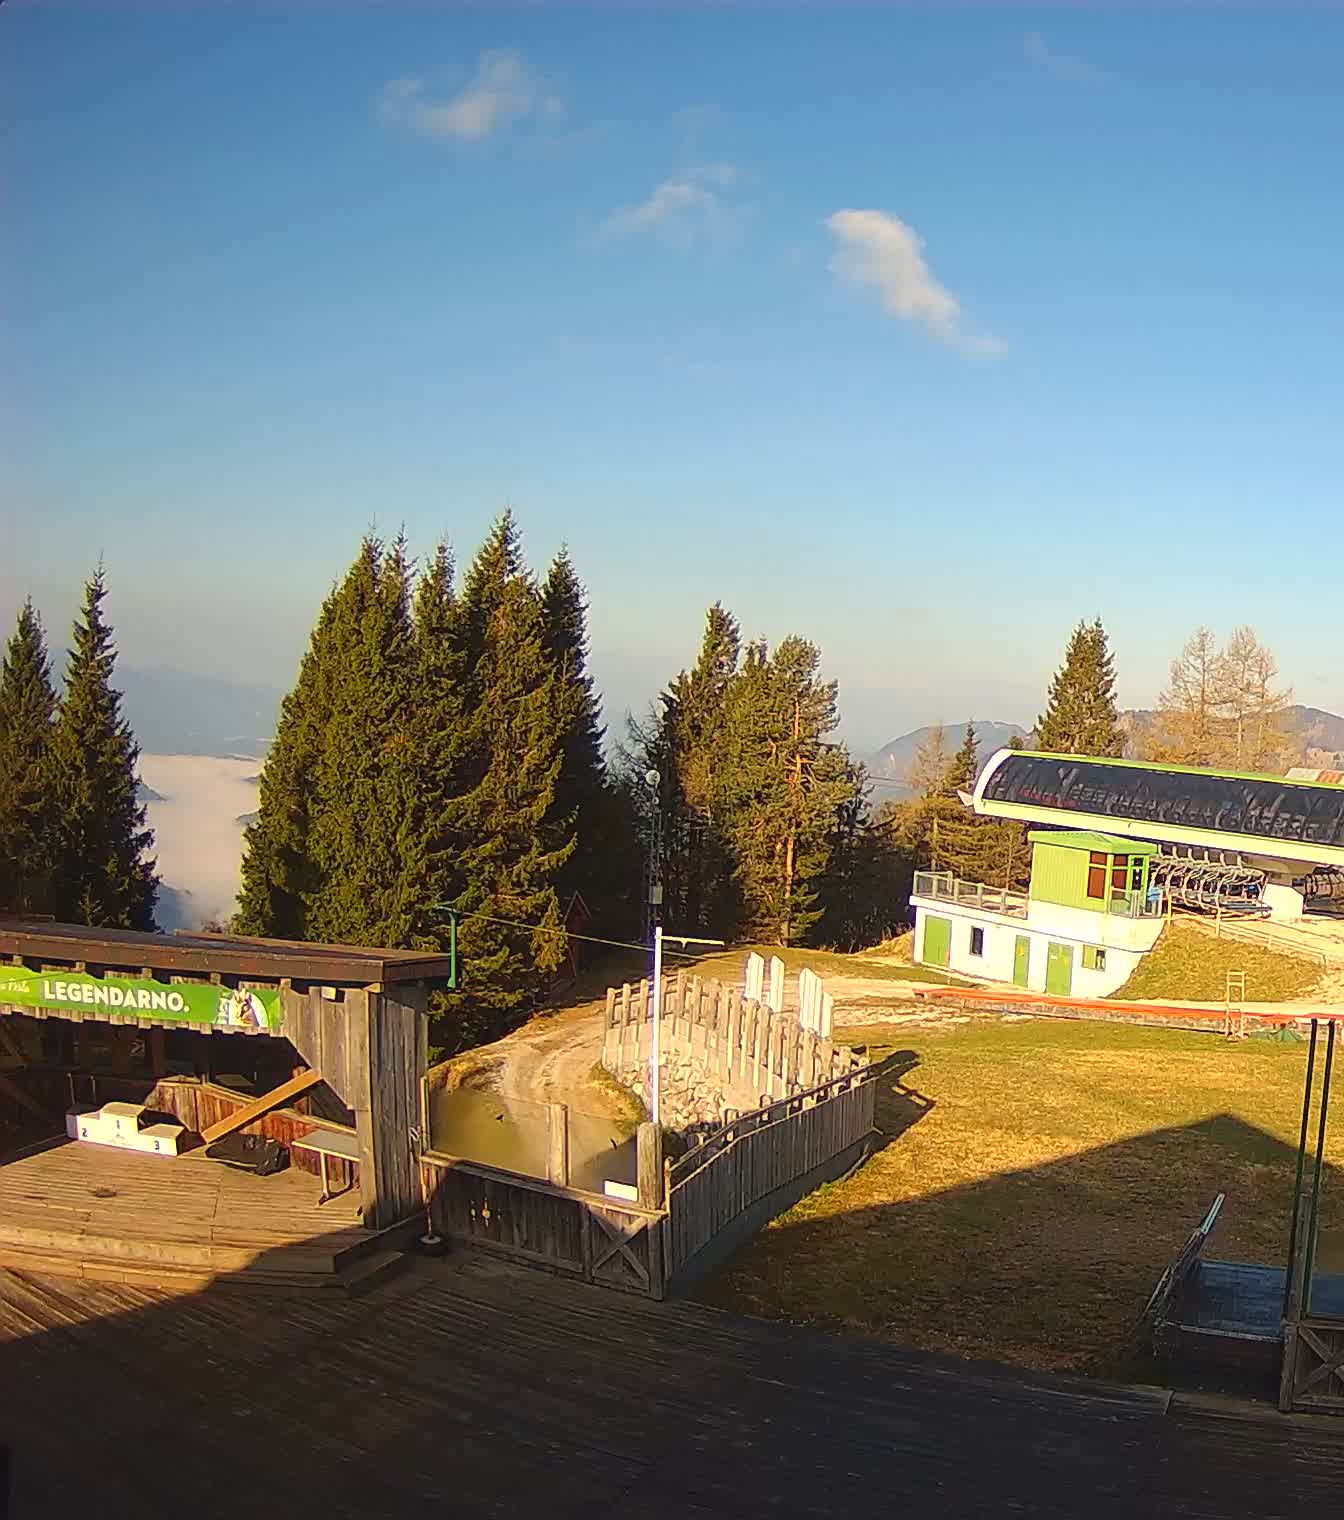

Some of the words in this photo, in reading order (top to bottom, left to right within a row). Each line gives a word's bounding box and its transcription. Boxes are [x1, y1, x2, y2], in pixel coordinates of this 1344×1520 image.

[43, 980, 191, 1012] LEGENDARNO.
[82, 1128, 88, 1137] 2
[154, 1140, 160, 1150] 3
